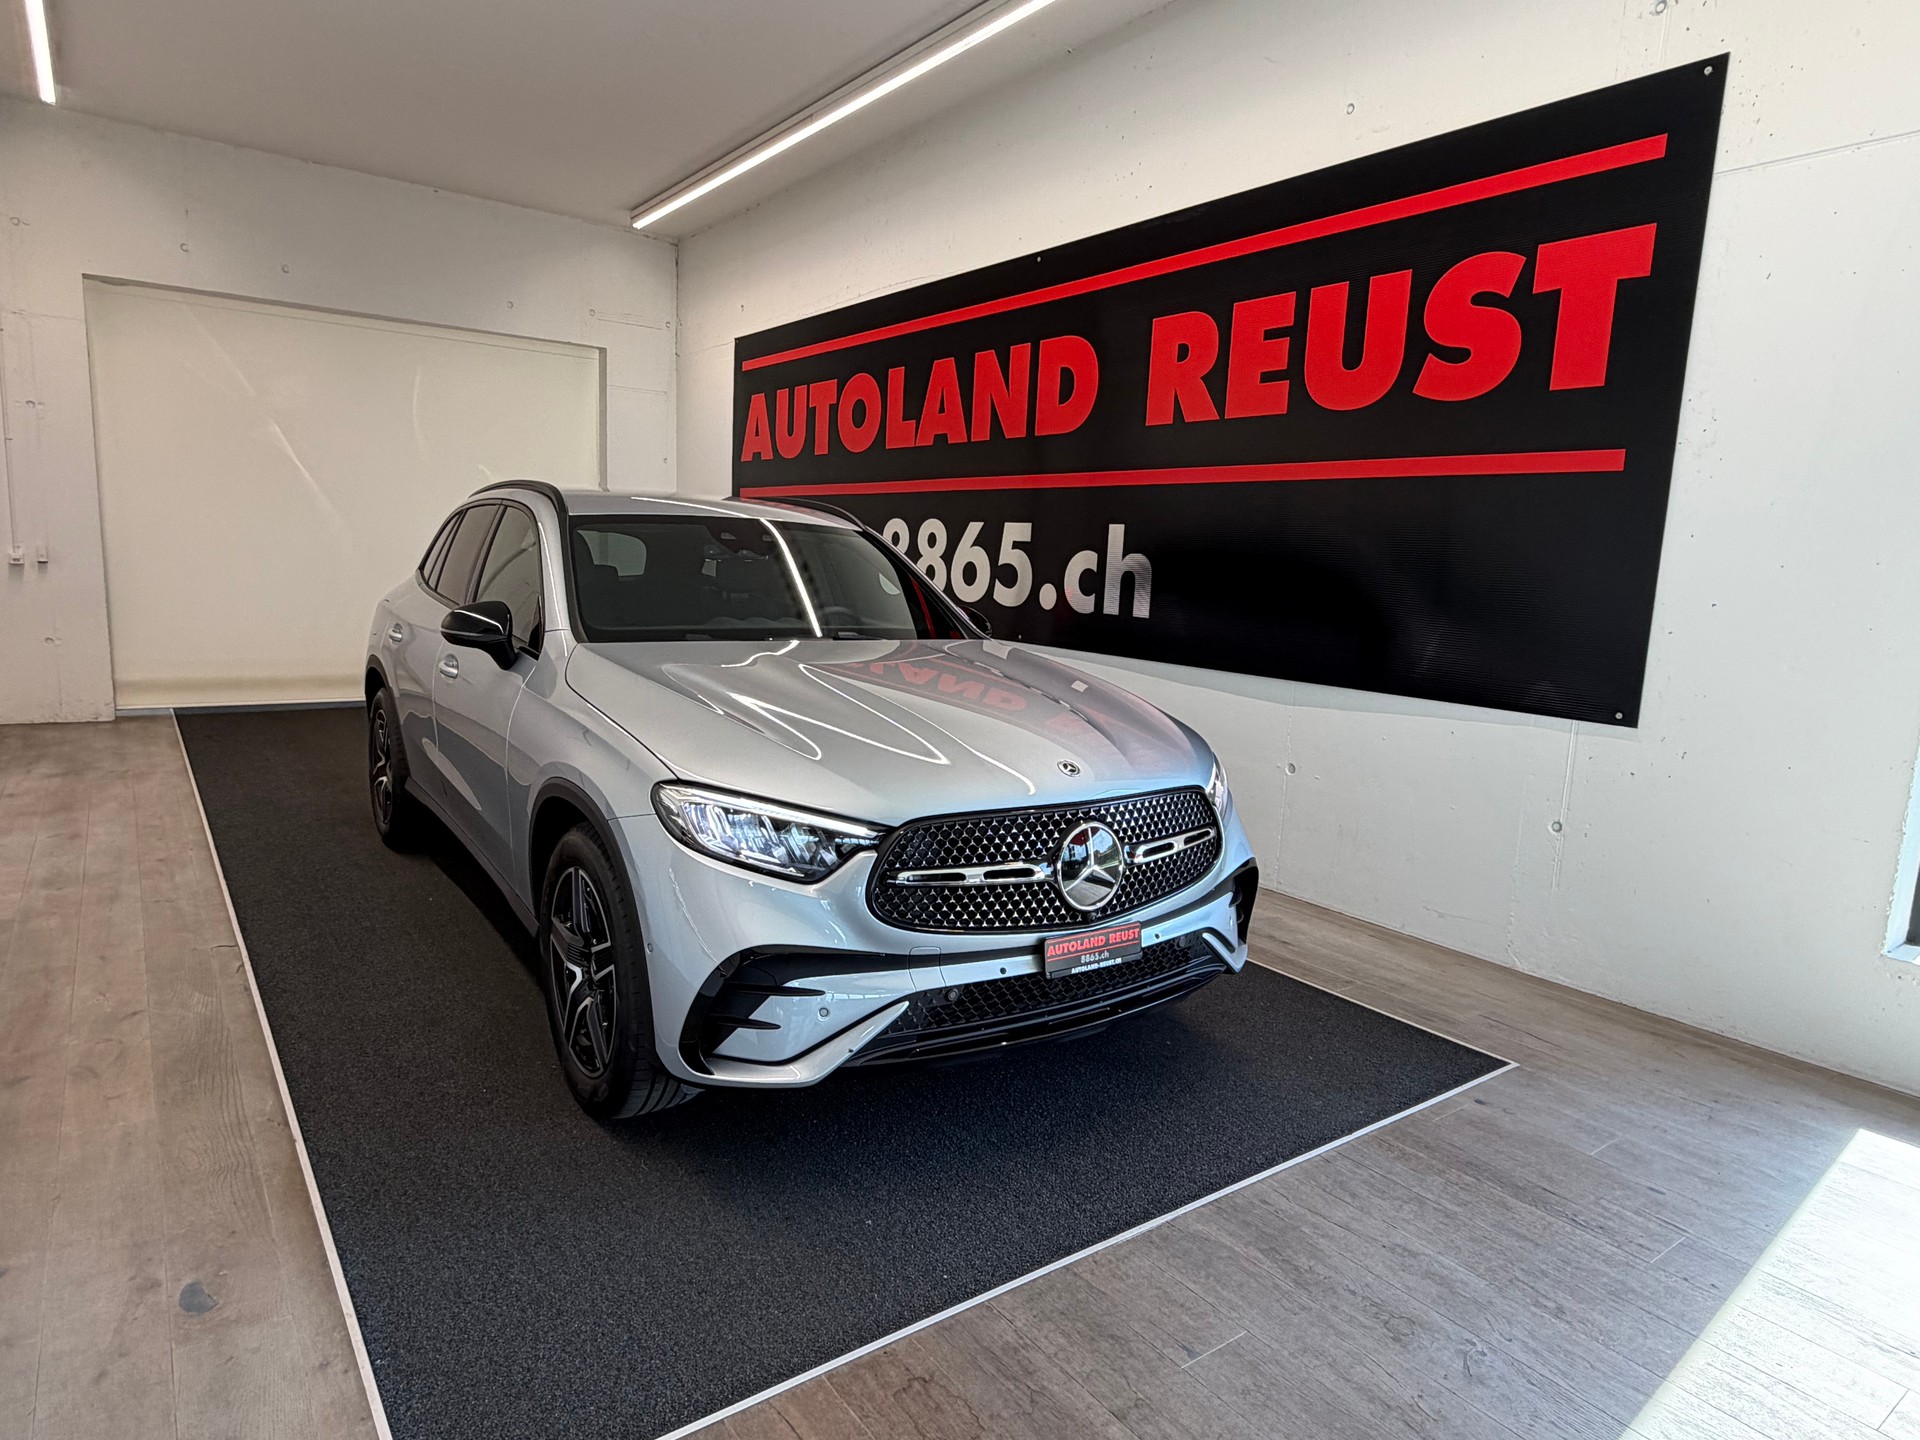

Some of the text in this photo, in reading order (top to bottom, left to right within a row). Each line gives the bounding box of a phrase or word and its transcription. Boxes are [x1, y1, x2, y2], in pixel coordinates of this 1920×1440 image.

[740, 222, 1657, 462] AUTOLAND REUST
[1047, 928, 1140, 956] AUTOLAND REUST
[1080, 950, 1110, 964] 8865.ch
